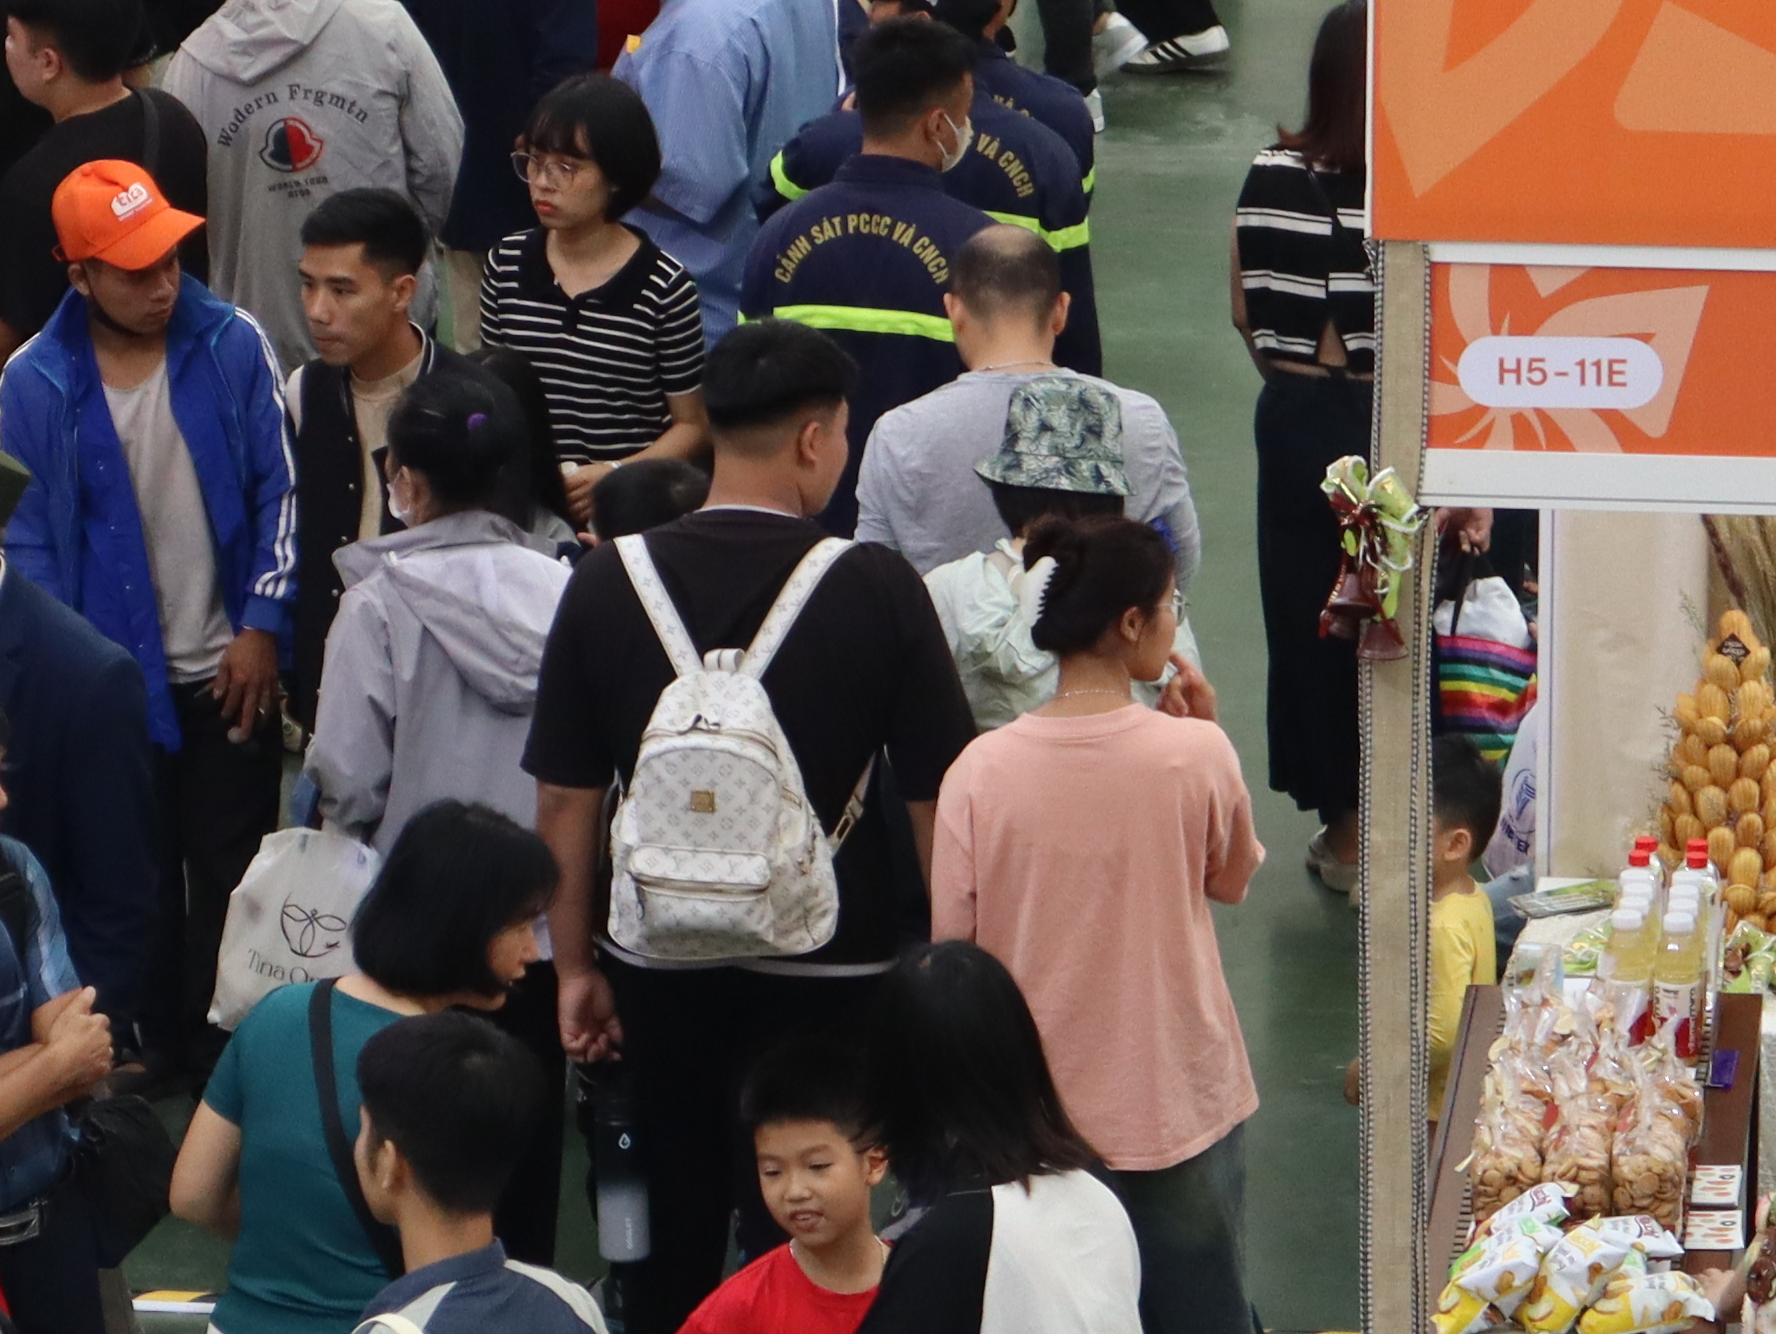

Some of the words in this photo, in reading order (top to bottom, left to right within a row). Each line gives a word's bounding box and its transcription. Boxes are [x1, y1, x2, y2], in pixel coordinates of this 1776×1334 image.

[218, 90, 279, 149] Wodern
[287, 83, 370, 125] Frgmtn
[976, 132, 1001, 160] VÀ
[999, 152, 1035, 198] CNCH
[775, 234, 812, 285] CẢNH
[810, 214, 843, 244] SÁT
[846, 212, 891, 236] PCCC
[892, 222, 916, 247] VÀ
[912, 234, 951, 285] CNCH
[1497, 357, 1628, 388] H5-11E
[248, 948, 285, 980] Tina
